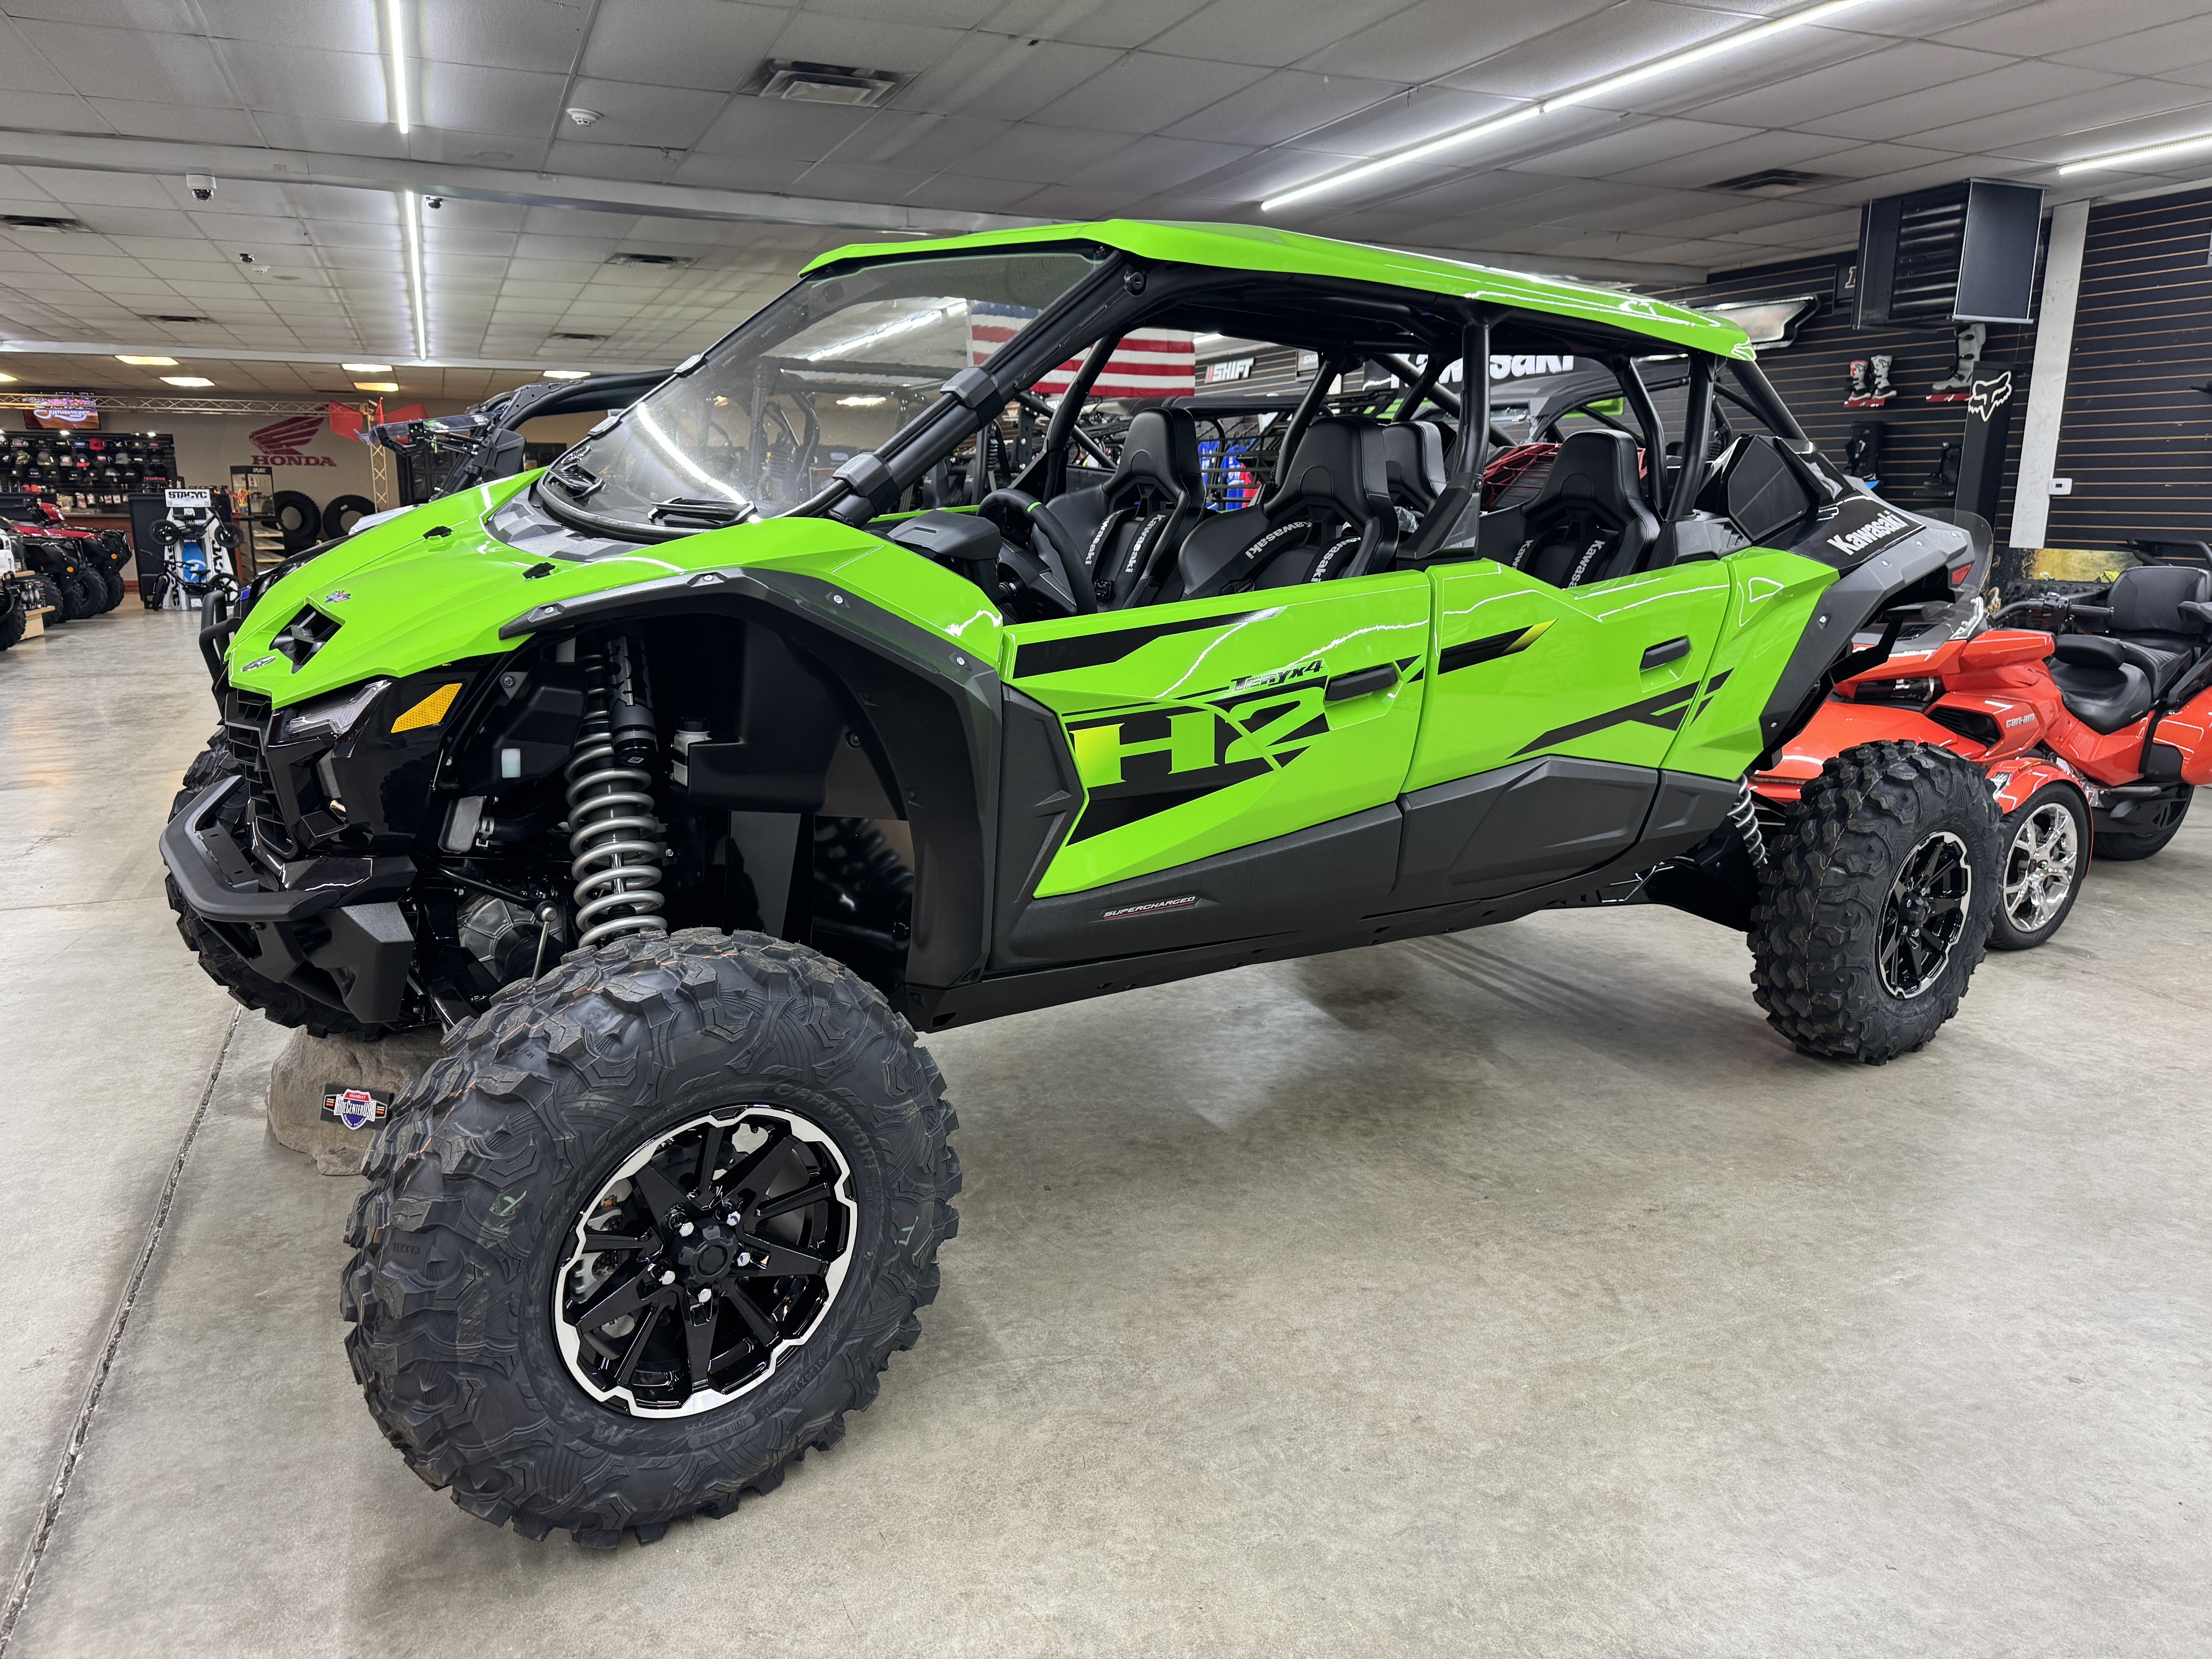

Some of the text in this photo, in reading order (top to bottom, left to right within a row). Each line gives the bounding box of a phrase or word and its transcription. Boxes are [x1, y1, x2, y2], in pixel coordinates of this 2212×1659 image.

[251, 455, 337, 467] HONDA
[1125, 514, 1166, 572] Kawasaki
[1827, 510, 1909, 555] Kawasaki
[1069, 685, 1324, 788] H2
[2005, 713, 2035, 728] can-am
[1103, 896, 1196, 917] SUPERCHARGED
